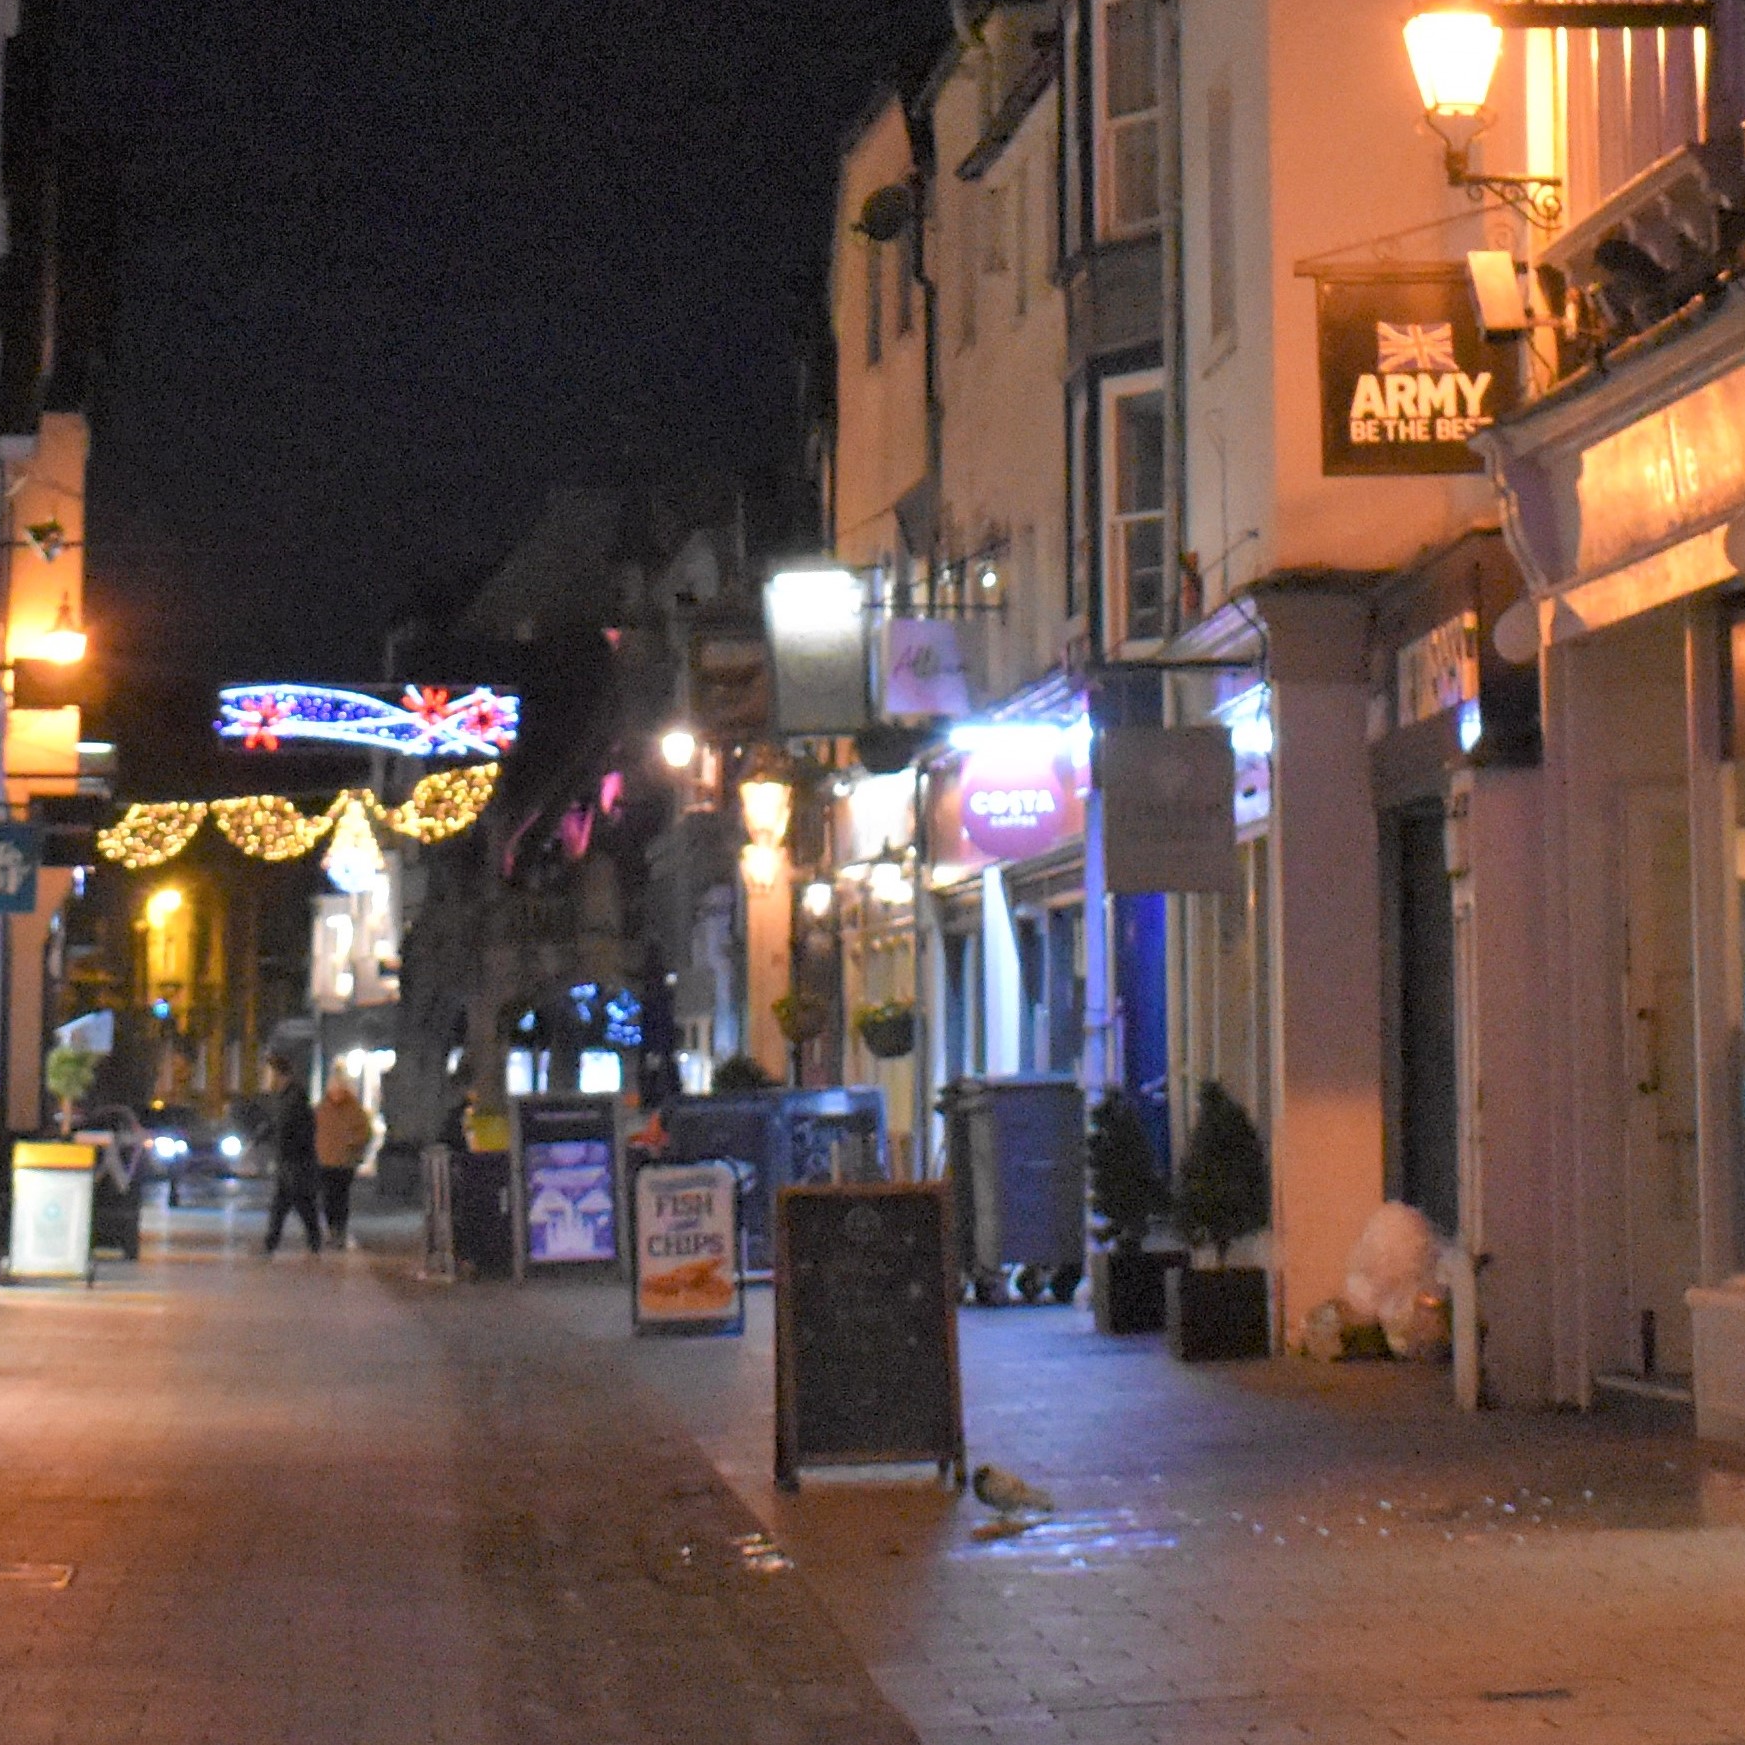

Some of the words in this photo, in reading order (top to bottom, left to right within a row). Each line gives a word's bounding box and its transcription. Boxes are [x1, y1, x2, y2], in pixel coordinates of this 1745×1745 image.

[1350, 372, 1493, 419] ARMY
[1350, 420, 1381, 443] BE
[1382, 419, 1432, 442] THE
[969, 789, 1056, 815] COSTA
[655, 1192, 714, 1218] FISH
[647, 1232, 725, 1257] CHIPS
